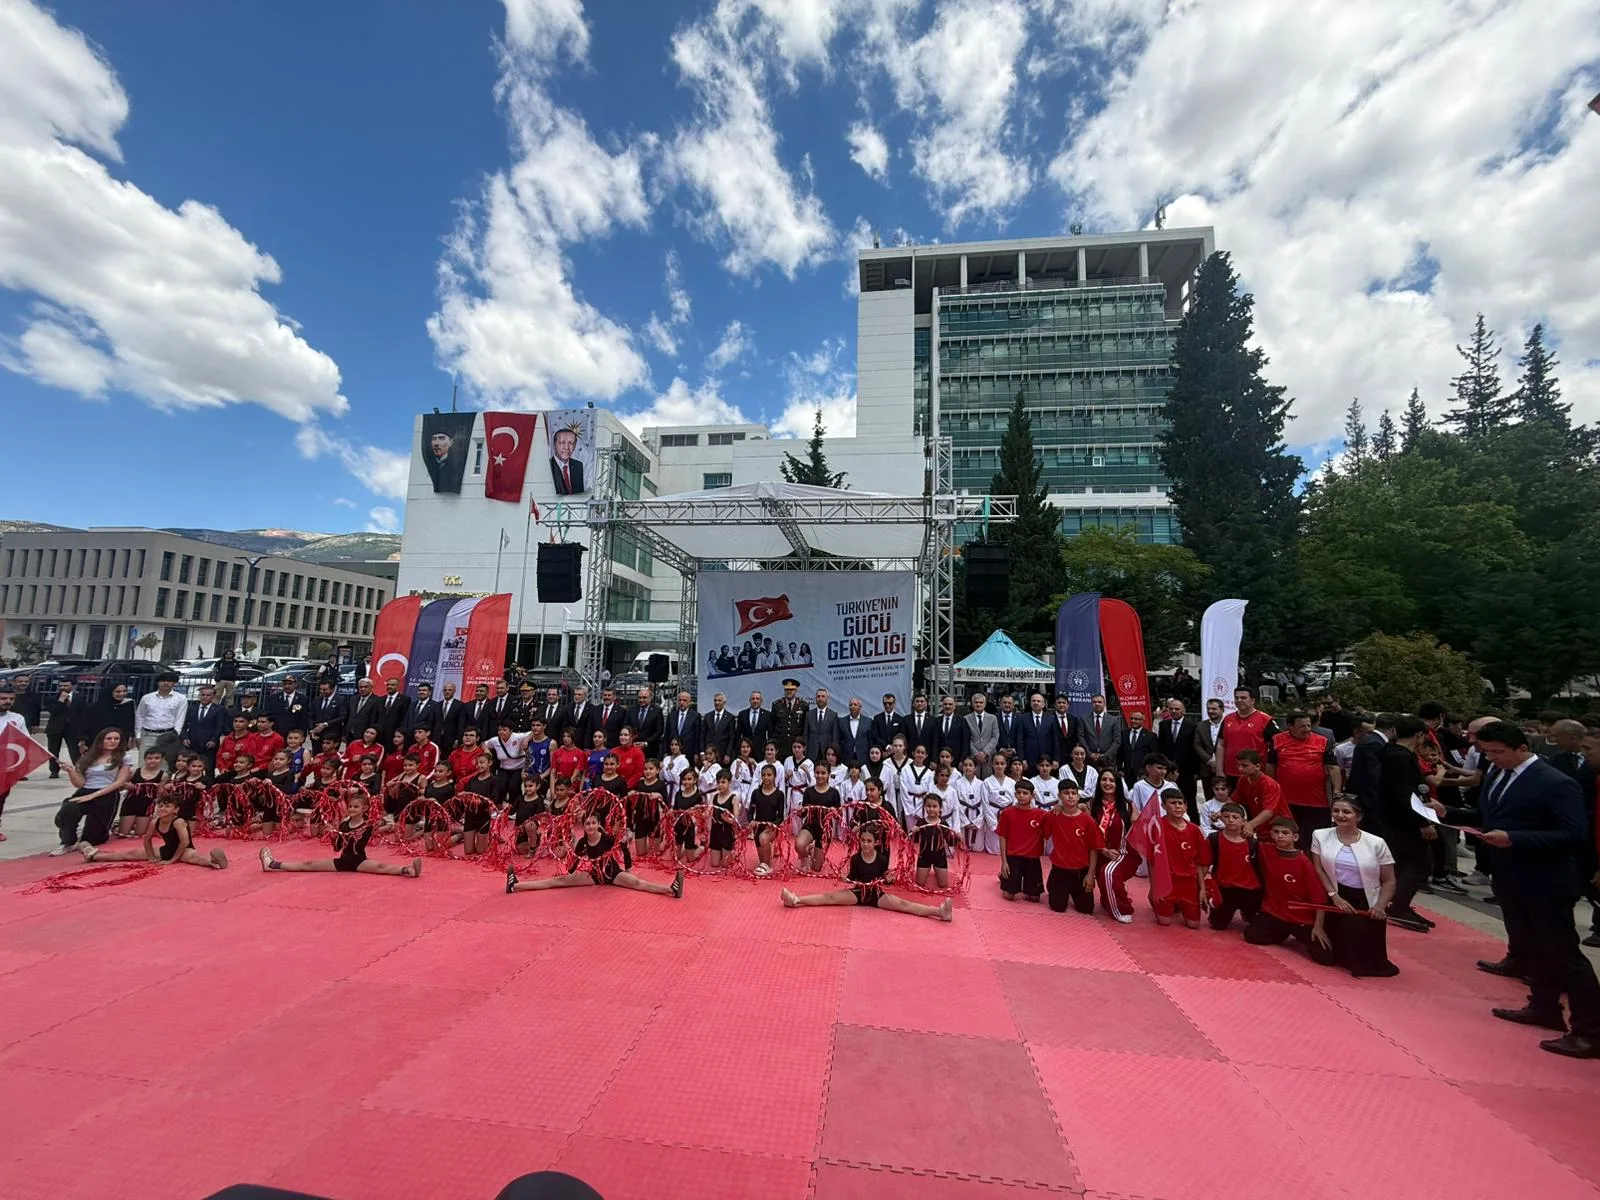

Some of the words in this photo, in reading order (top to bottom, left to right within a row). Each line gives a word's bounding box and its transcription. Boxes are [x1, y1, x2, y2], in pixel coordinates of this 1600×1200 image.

[843, 612, 891, 637] GÜCÜ
[828, 632, 906, 660] GENÇLİĞİ
[966, 668, 1005, 679] Kahramanmaraş
[1006, 668, 1033, 680] Büyükşehir
